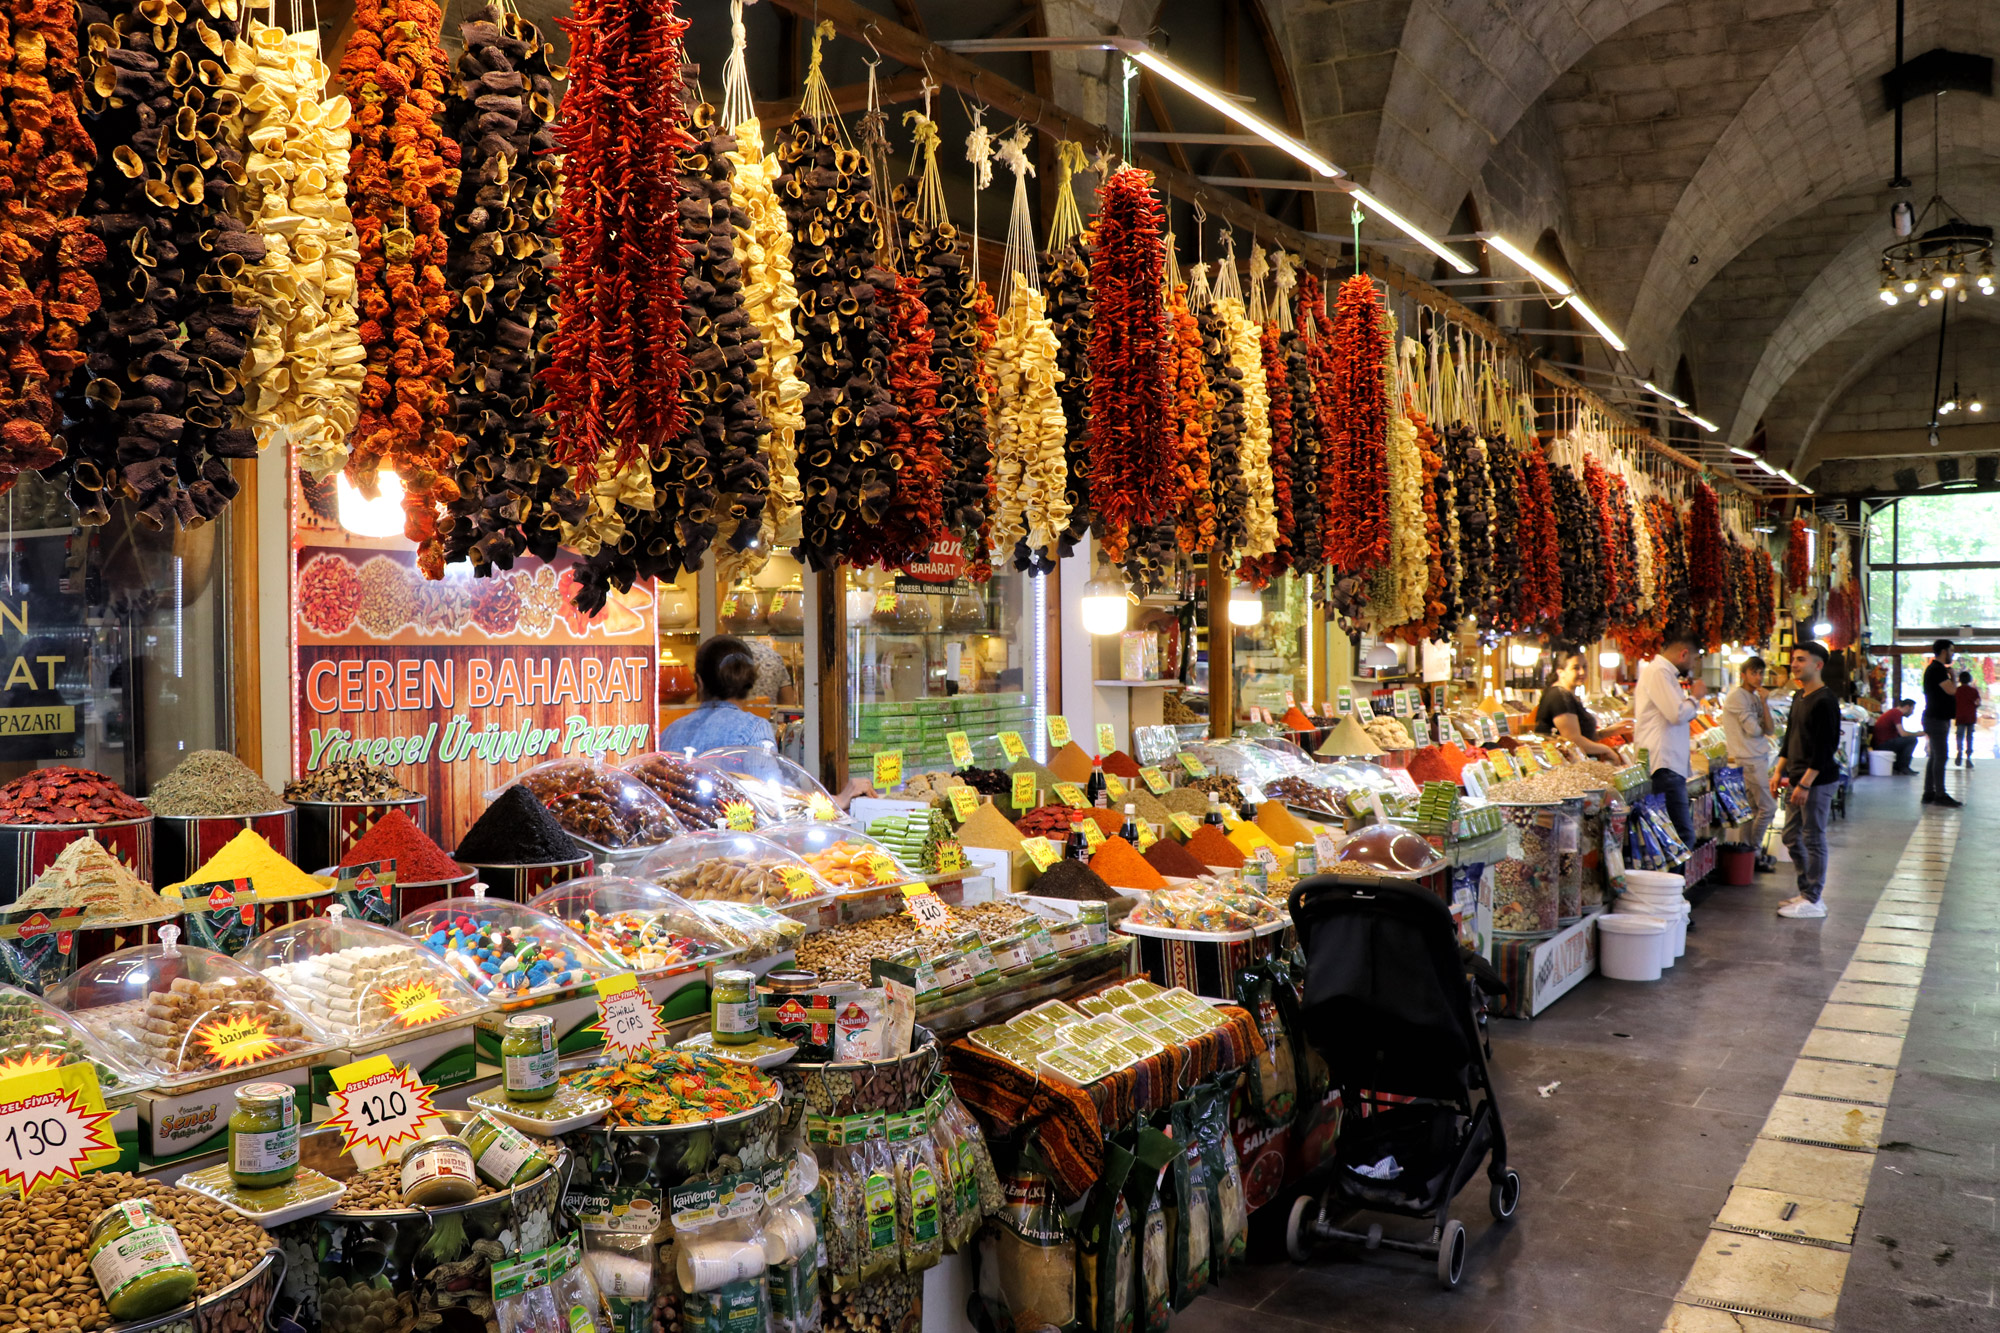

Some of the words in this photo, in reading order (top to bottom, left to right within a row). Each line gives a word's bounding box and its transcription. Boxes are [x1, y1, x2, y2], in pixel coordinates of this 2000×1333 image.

[911, 562, 956, 576] BAHARAT
[896, 584, 922, 593] YÖRESEL
[922, 584, 949, 594] ÜRÜNLER
[949, 586, 969, 595] PAZARI
[307, 659, 454, 713] CEREN
[468, 657, 648, 707] BAHARAT
[0, 713, 61, 732] PAZARI
[307, 722, 438, 771] Yöresel
[438, 714, 560, 765] Ürünler
[563, 714, 649, 756] Pazarı
[210, 896, 234, 905] Tahmis
[921, 905, 941, 921] 140
[20, 923, 50, 932] Tahmis
[1552, 931, 1584, 988] ANTEP
[777, 1010, 806, 1019] Tahmis
[838, 1017, 869, 1025] Tahmis
[347, 1080, 368, 1092] ÖZEL
[361, 1091, 407, 1126] 120
[5, 1118, 67, 1160] 130
[1017, 1221, 1059, 1240] Tarhana
